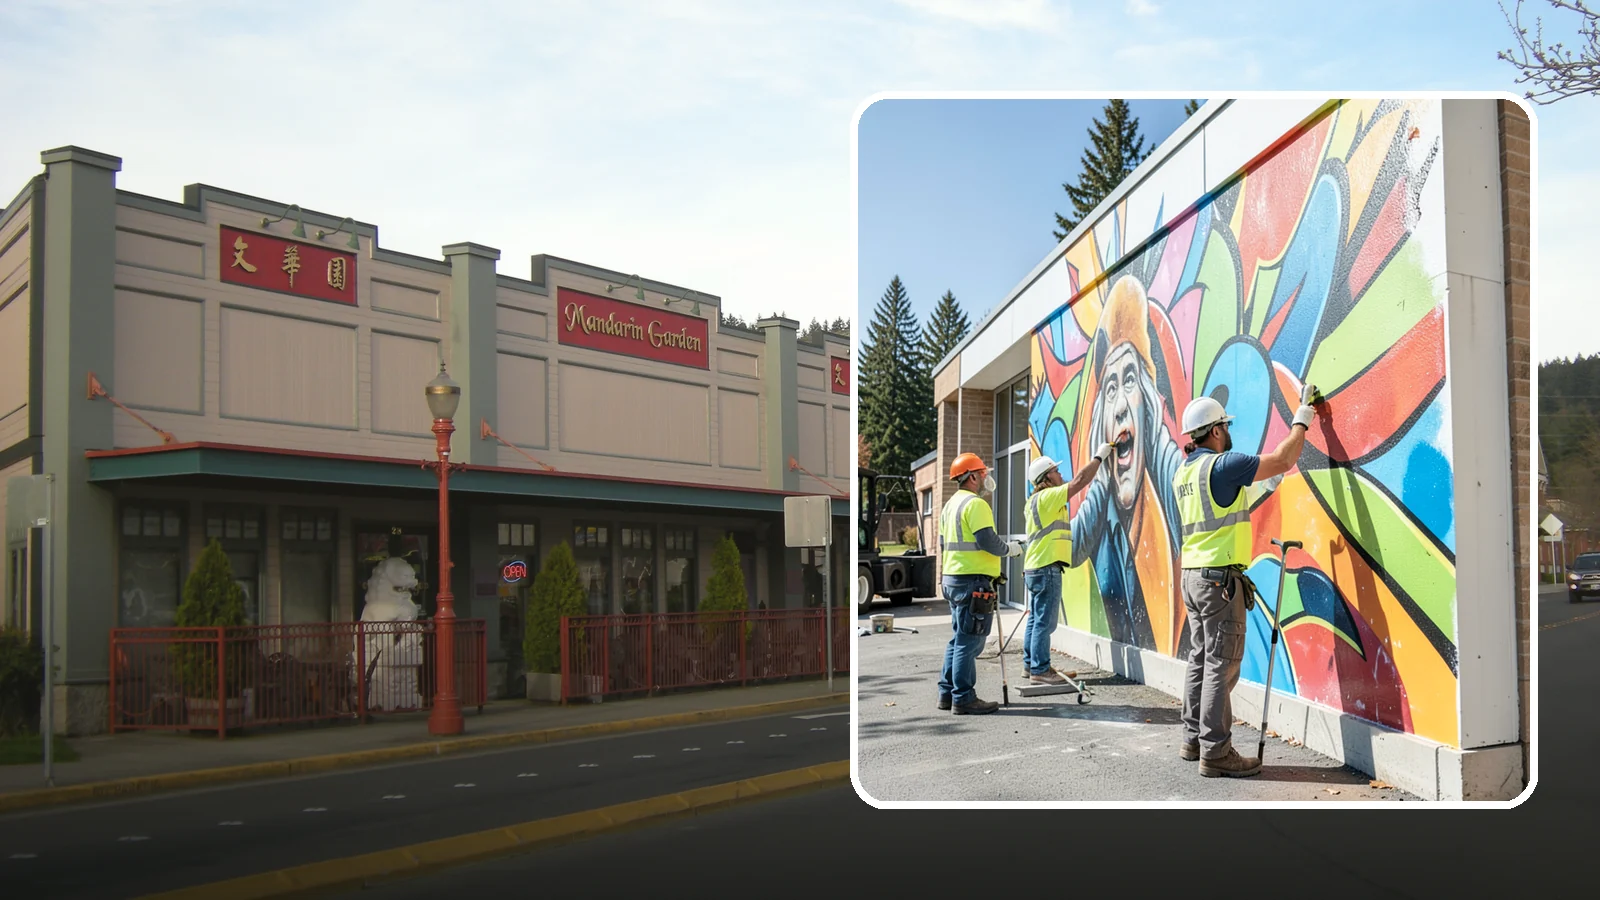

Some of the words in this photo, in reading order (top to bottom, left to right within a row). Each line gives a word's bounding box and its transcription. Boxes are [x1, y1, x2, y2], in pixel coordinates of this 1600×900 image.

[230, 235, 346, 291] 文華園
[564, 302, 644, 341] Mandarin
[648, 320, 702, 352] Garden
[834, 363, 846, 386] 文
[503, 565, 527, 579] OPEN
